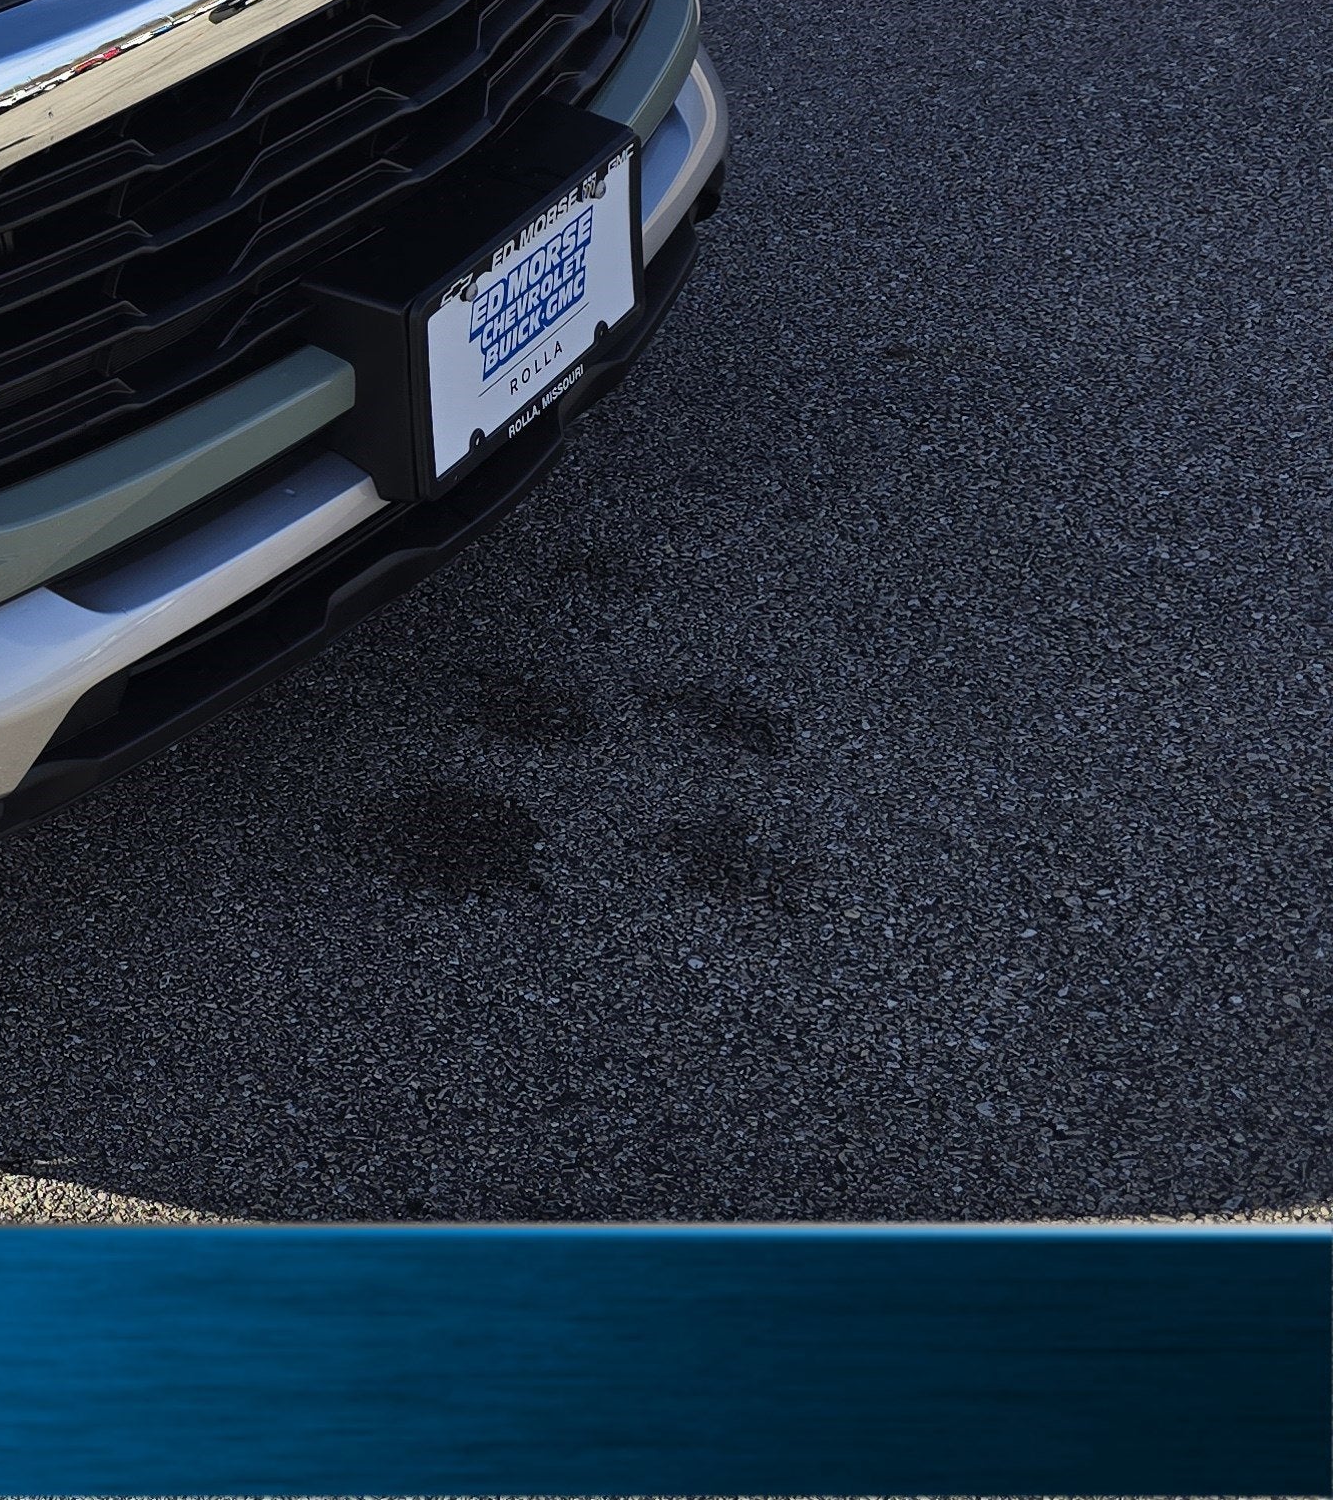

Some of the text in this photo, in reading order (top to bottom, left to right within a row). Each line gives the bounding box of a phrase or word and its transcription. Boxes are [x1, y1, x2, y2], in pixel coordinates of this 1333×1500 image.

[471, 208, 592, 335] ED MORSE
[492, 239, 515, 271] ED
[519, 187, 578, 246] MORSE
[482, 247, 586, 350] CHEVROLET
[484, 270, 585, 376] BUICK GMC
[508, 363, 584, 439] ROLLA, MISSOURI
[509, 340, 563, 396] ROLLA
